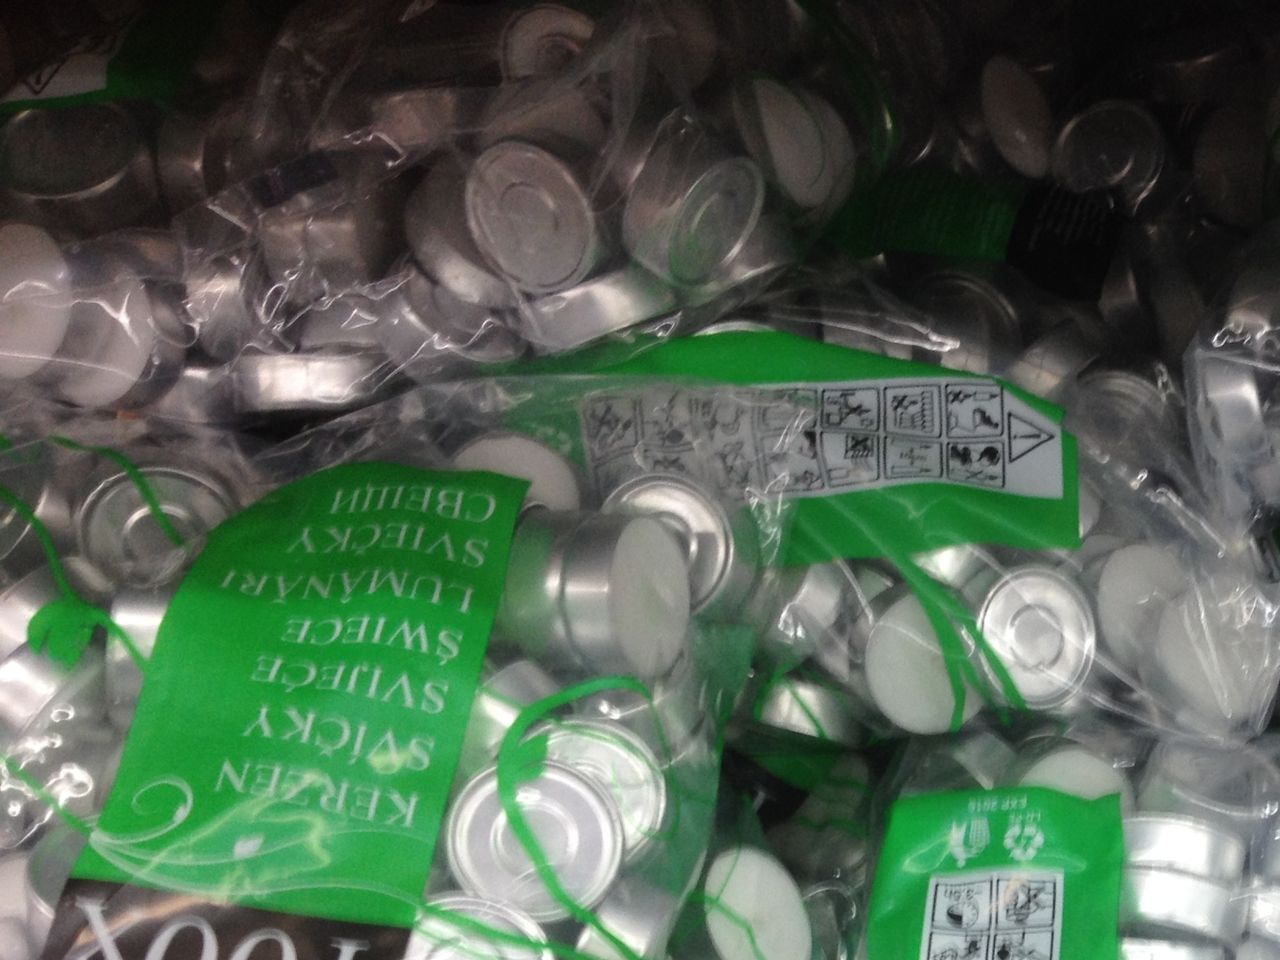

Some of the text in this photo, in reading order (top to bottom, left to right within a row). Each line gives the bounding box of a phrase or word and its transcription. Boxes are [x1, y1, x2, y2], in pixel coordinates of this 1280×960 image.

[286, 522, 491, 569] SVIEČKY
[242, 704, 437, 771] SVÍČKY
[212, 758, 421, 829] KERZEN
